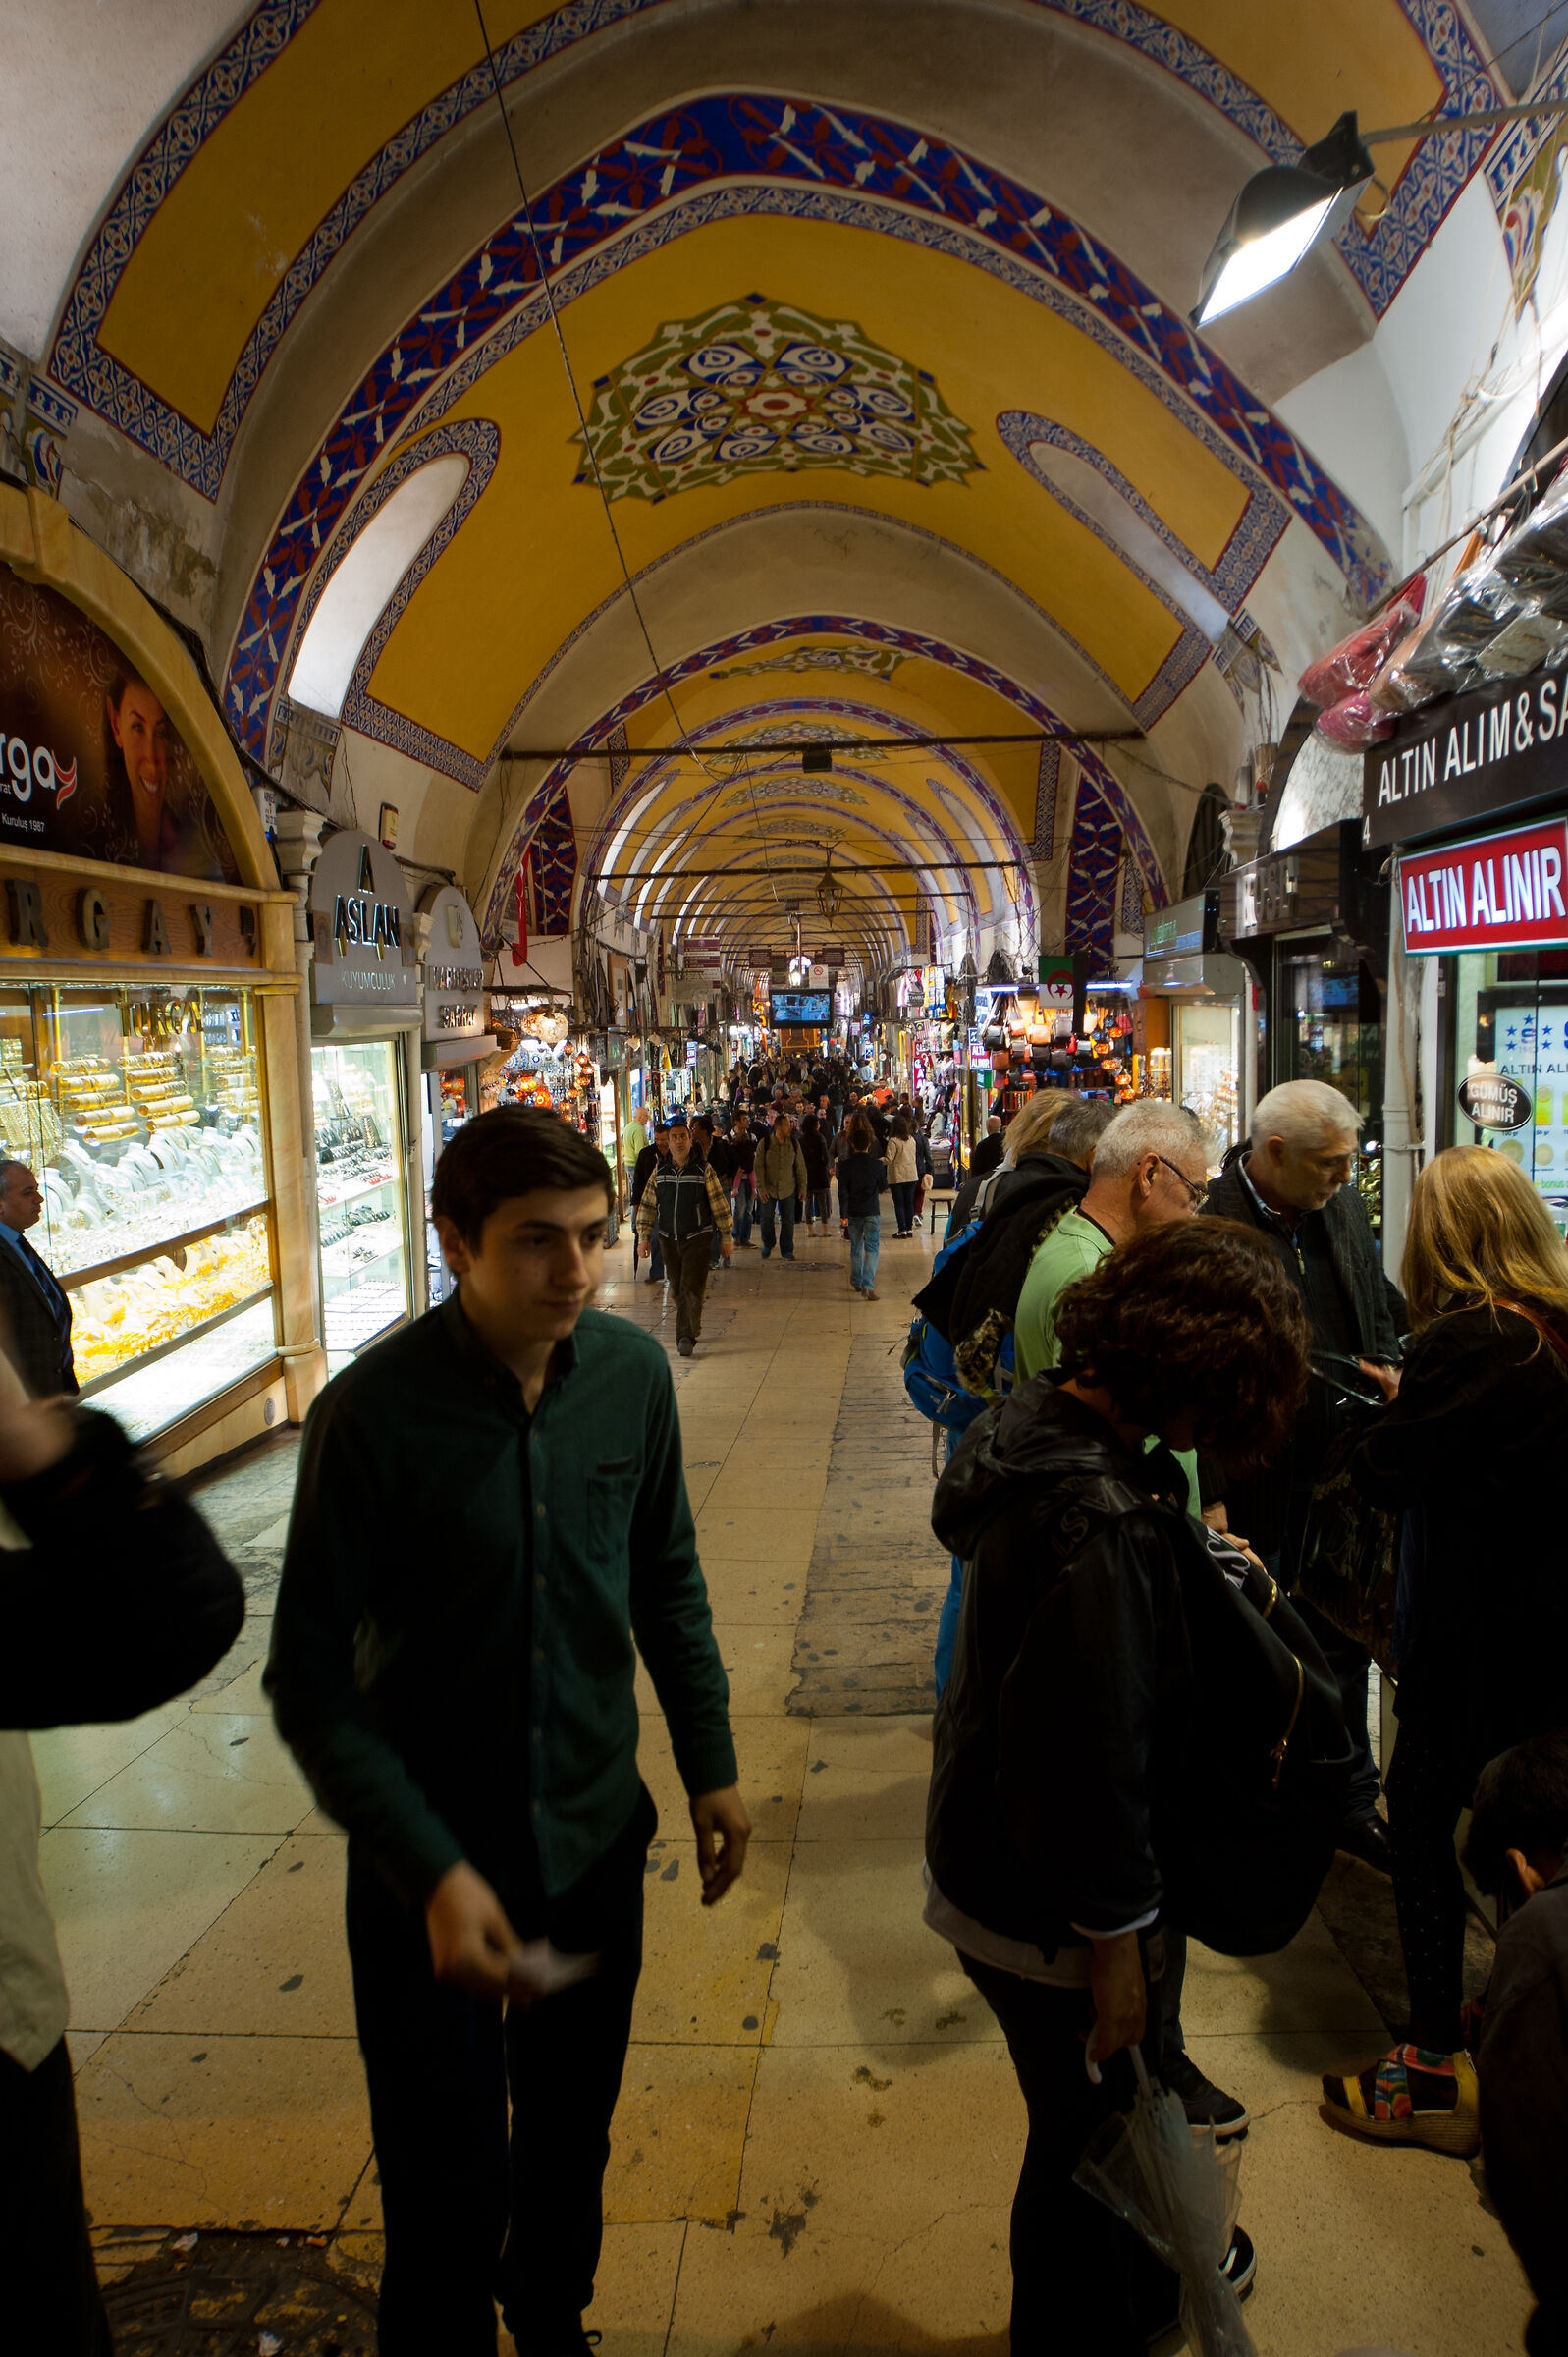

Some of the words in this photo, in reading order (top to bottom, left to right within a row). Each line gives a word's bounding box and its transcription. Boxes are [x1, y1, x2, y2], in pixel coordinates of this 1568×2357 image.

[1378, 738, 1436, 808] ALTIN
[2, 812, 27, 831] Kuruluş
[29, 819, 45, 832] 1987
[1363, 814, 1371, 845] 4
[1407, 865, 1467, 933] ALTIN
[1474, 846, 1566, 927] ALINIR
[334, 895, 401, 957] ASLAN
[1500, 1064, 1541, 1075] ALTIN
[1470, 1081, 1518, 1108] GÜMÜŞ
[1471, 1102, 1515, 1124] ALINIR
[1541, 1178, 1564, 1189] bonus
